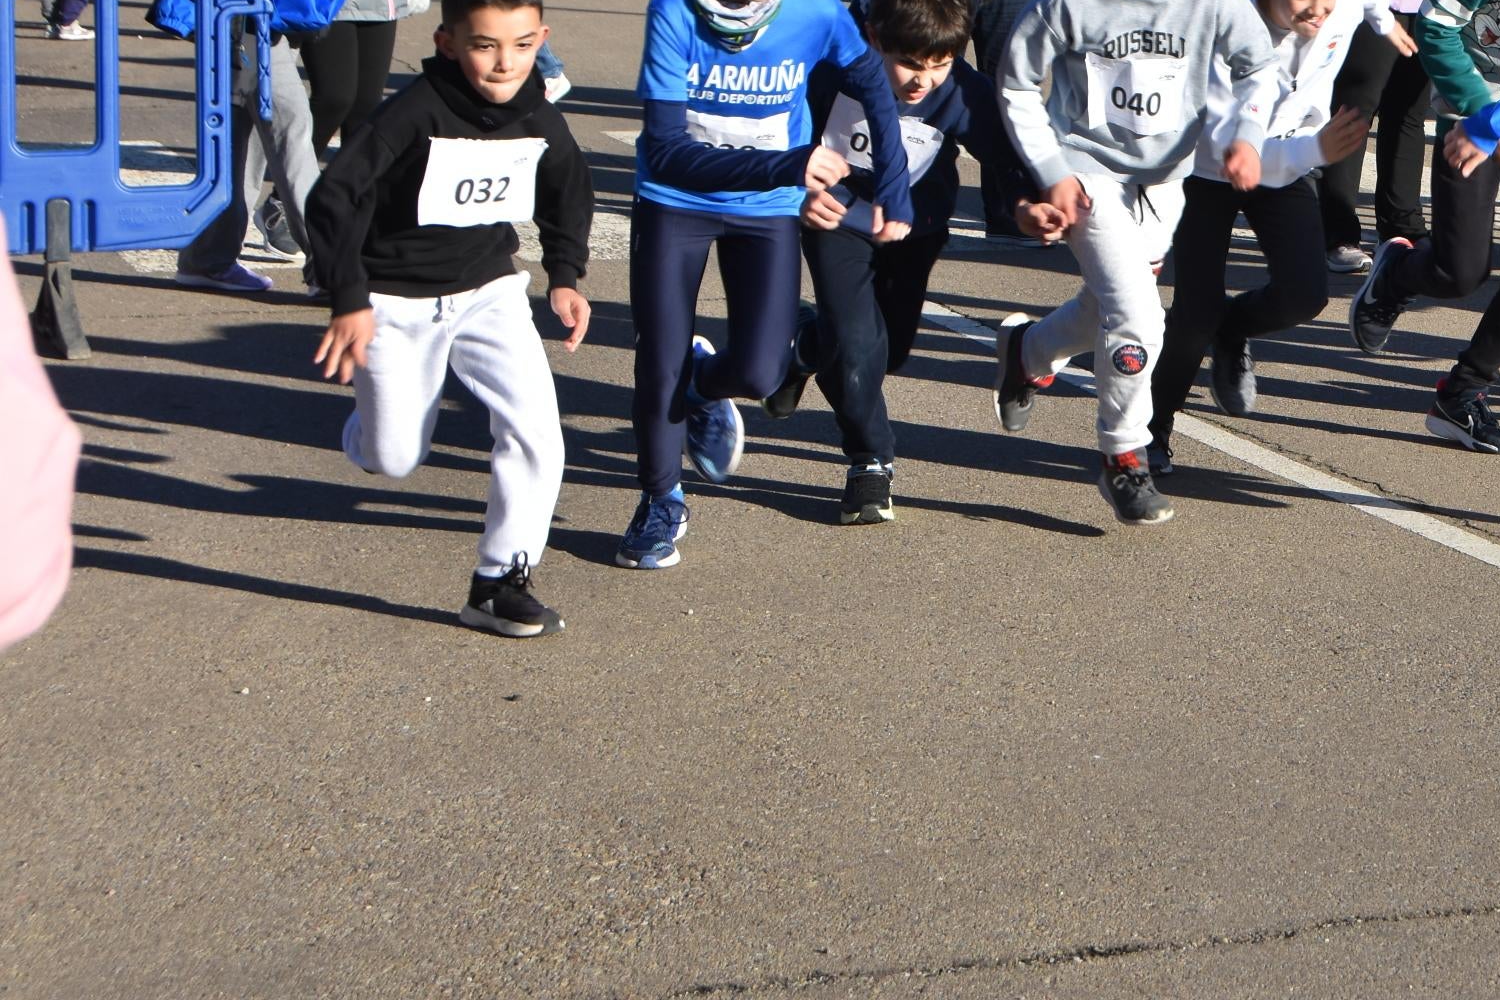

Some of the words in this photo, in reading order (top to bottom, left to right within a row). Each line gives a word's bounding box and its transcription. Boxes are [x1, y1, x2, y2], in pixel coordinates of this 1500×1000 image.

[704, 59, 806, 92] ARMUÑA
[1111, 86, 1161, 116] 040
[455, 176, 511, 205] 032
